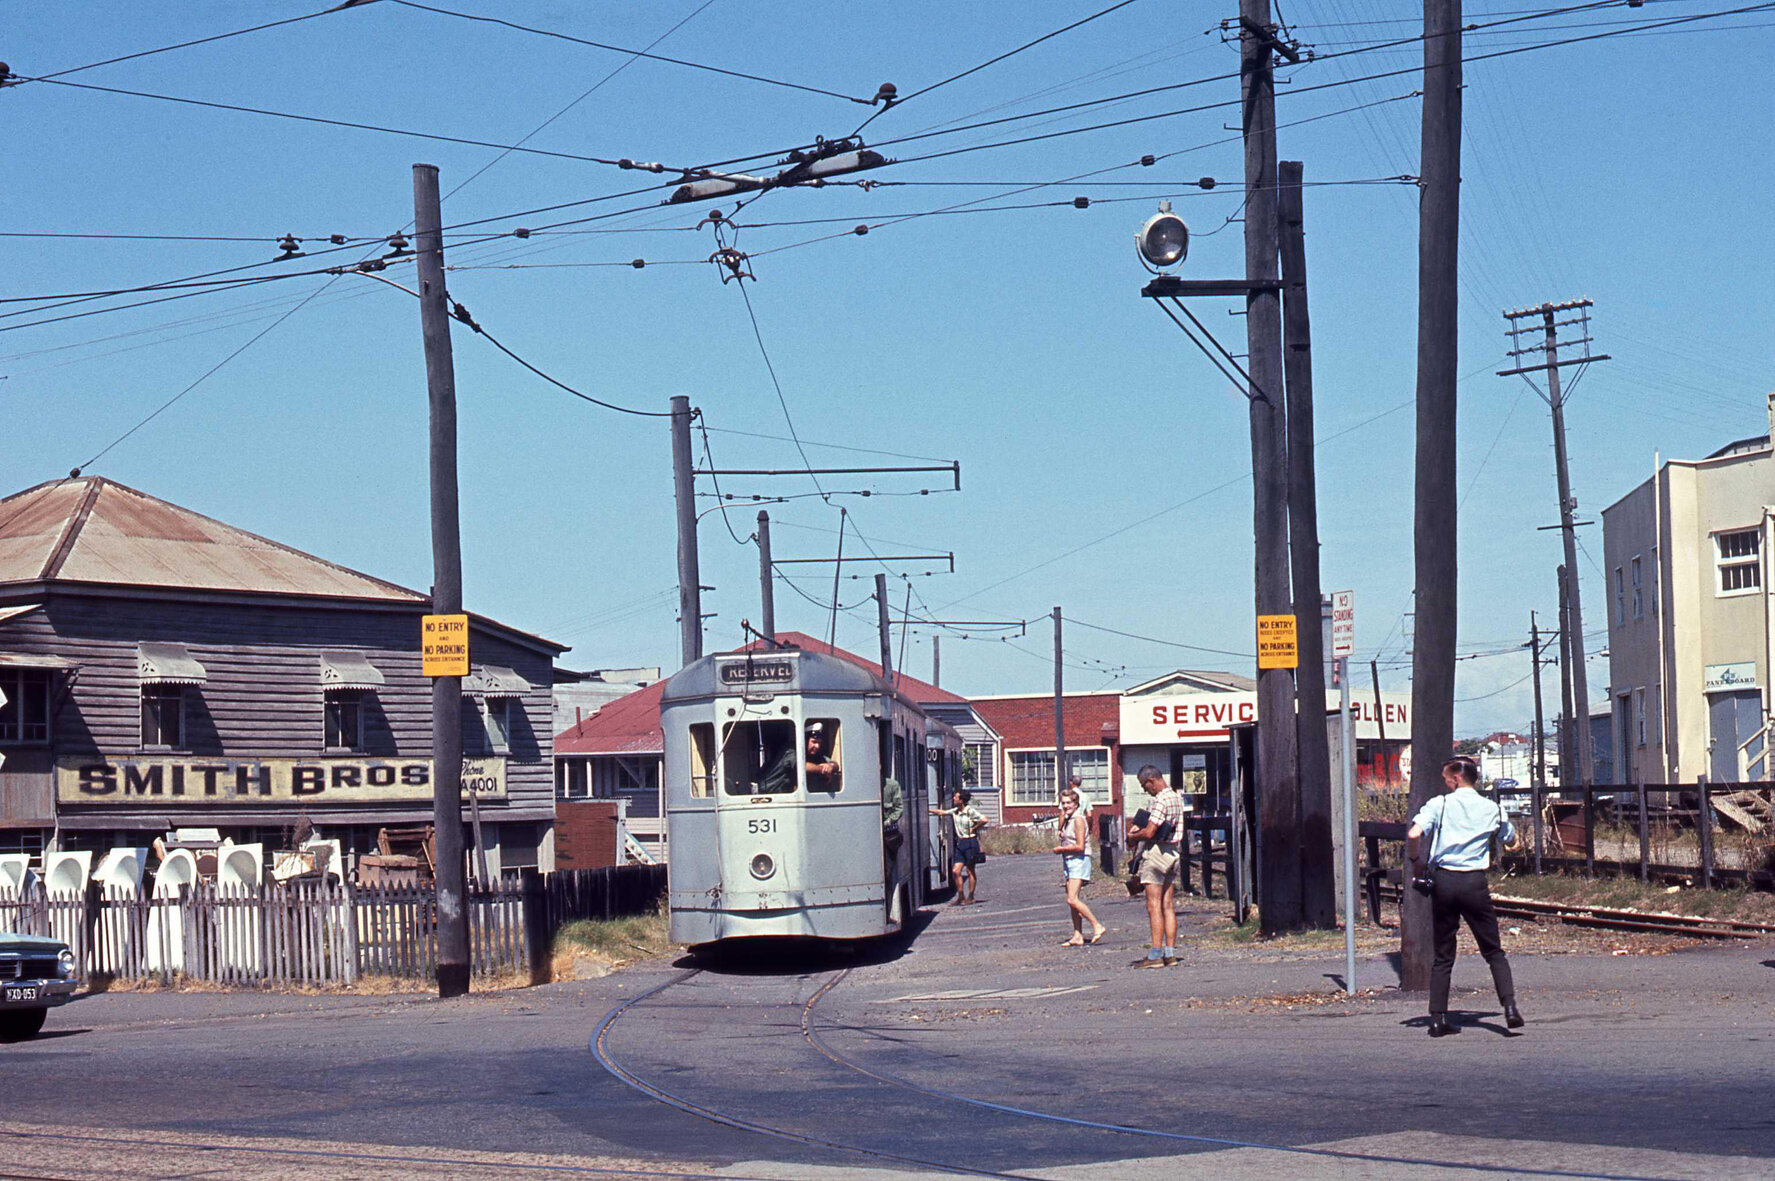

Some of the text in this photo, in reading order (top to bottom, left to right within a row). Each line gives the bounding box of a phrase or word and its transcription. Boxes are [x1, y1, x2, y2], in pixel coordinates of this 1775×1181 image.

[1338, 594, 1348, 607] NO
[1333, 608, 1353, 622] STANDING
[425, 622, 464, 632] NO ENTRY
[1260, 621, 1293, 629] NO ENTRY
[424, 644, 466, 655] NO PARKING
[1260, 642, 1295, 650] NO PARKING
[1153, 702, 1253, 724] SERVIC
[1339, 701, 1406, 723] OLDEN
[78, 764, 429, 796] SMITH BROS
[748, 819, 776, 834] 531
